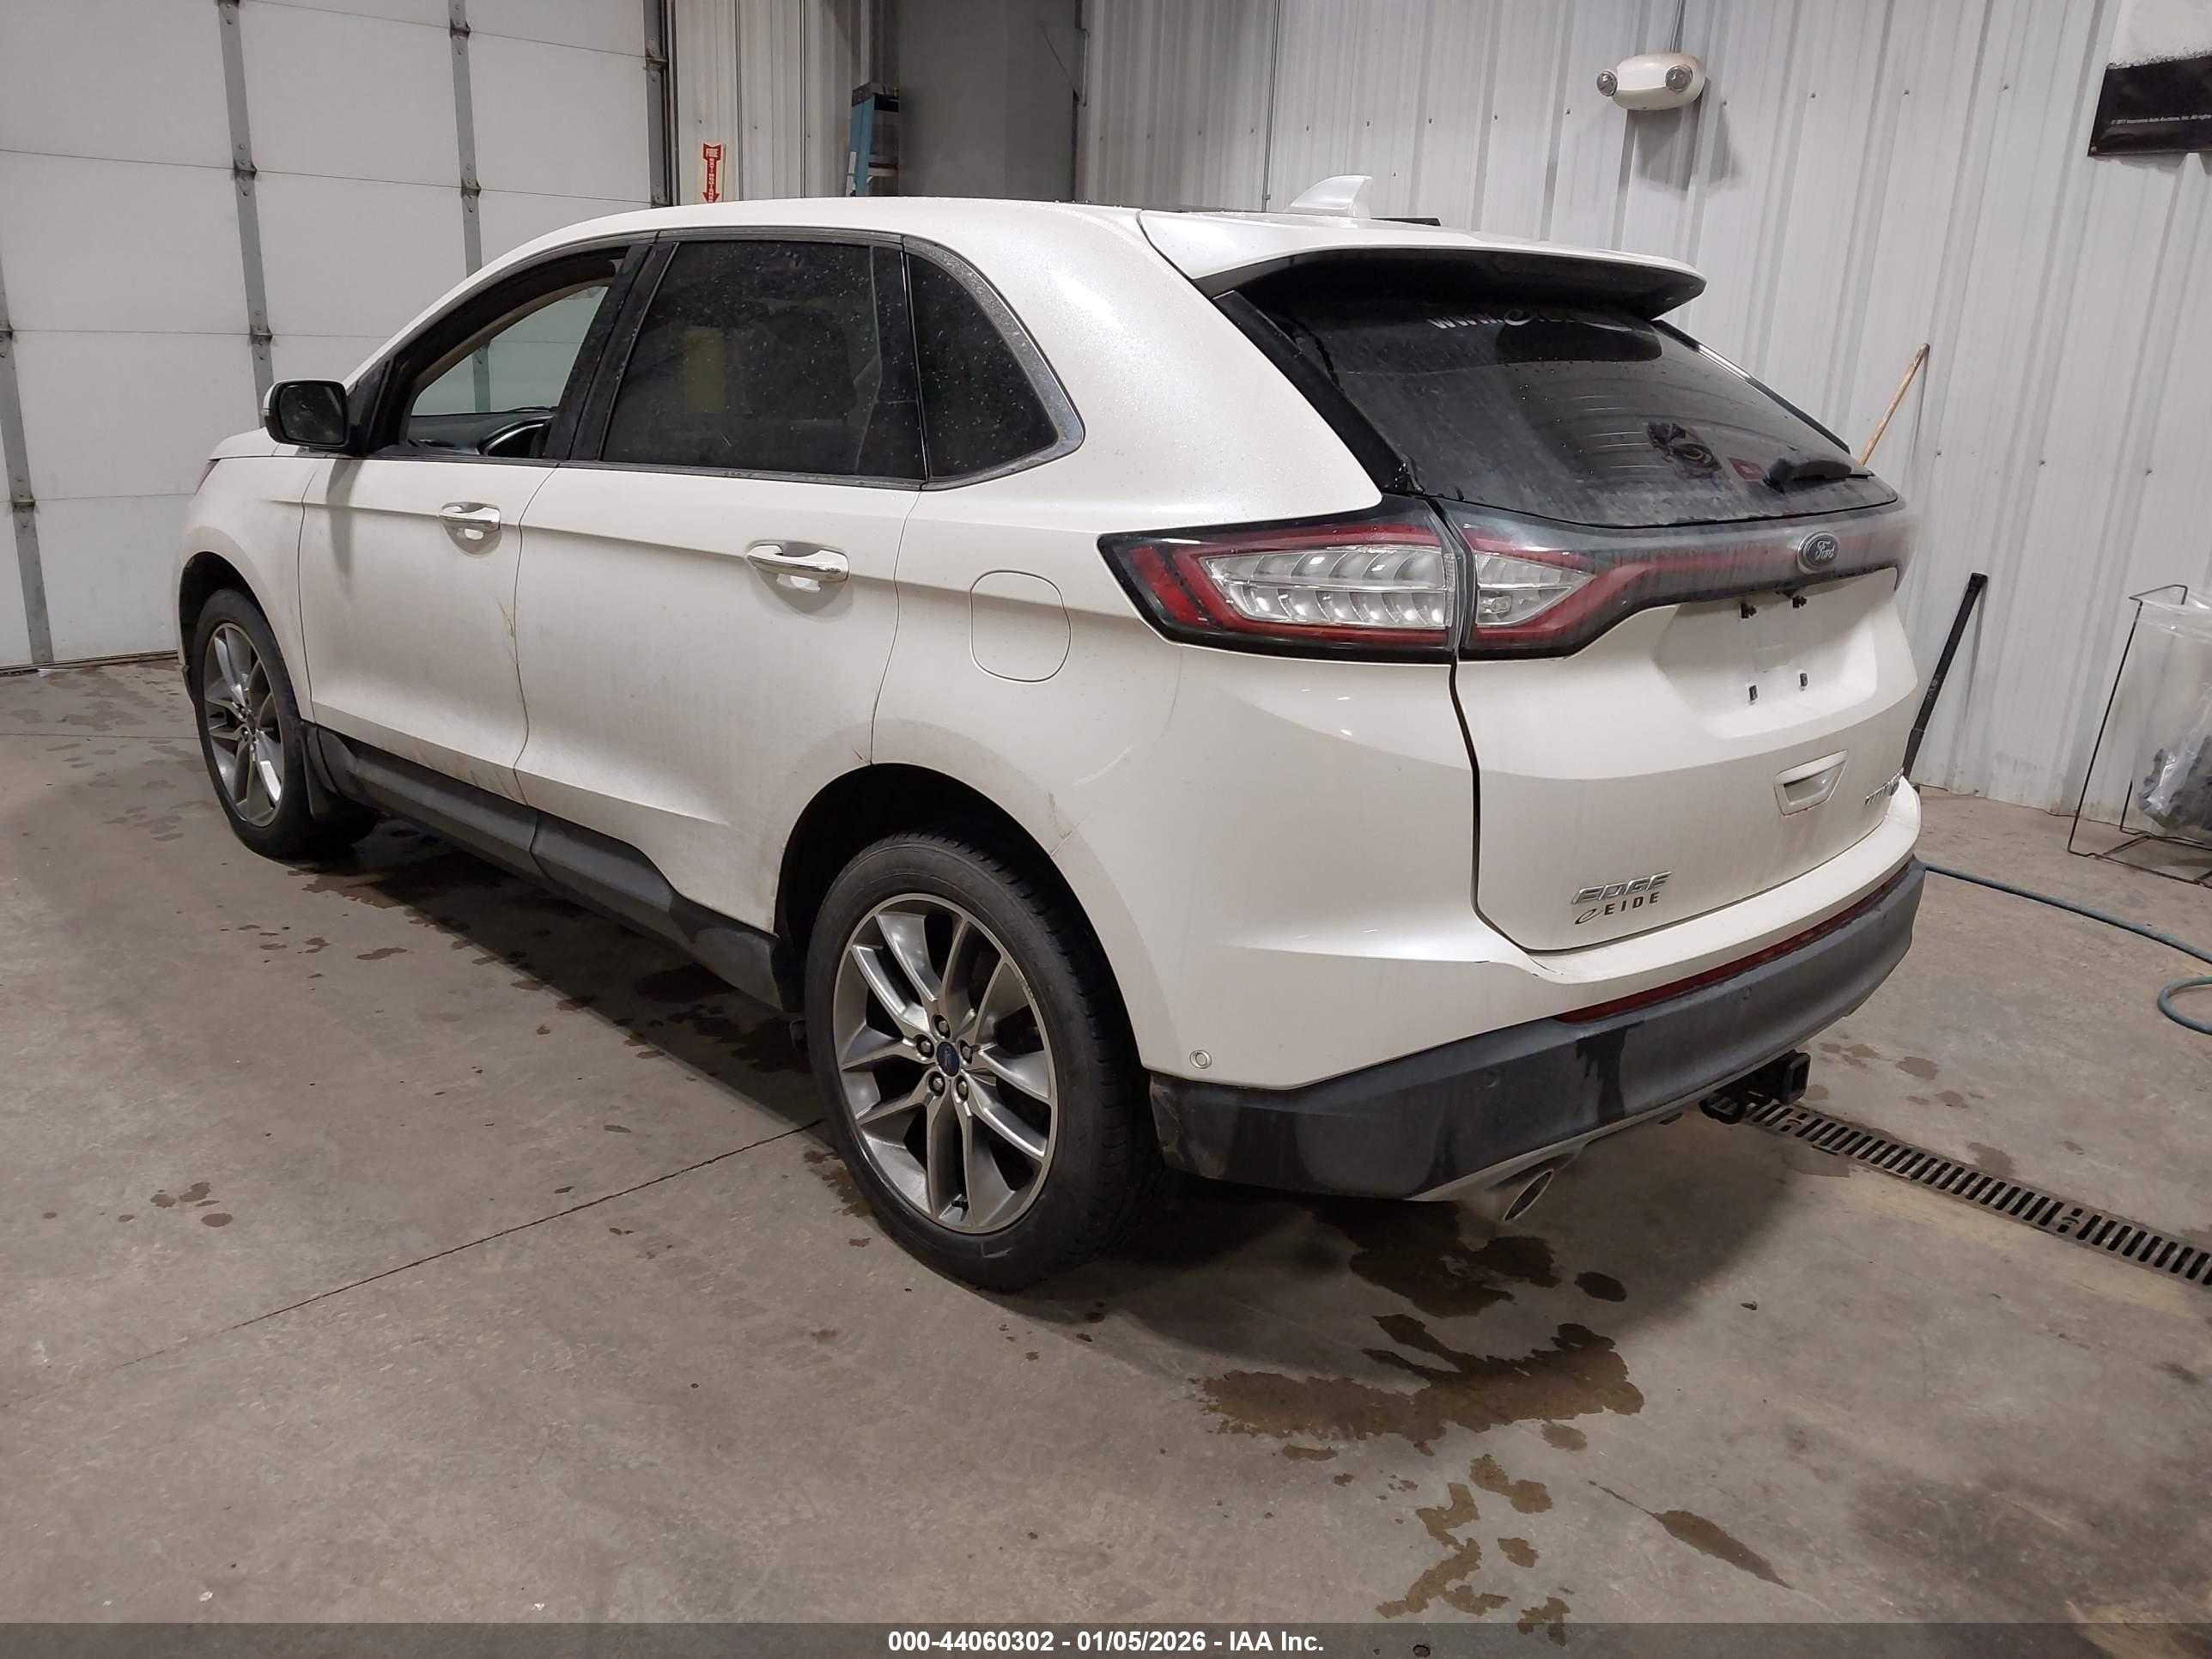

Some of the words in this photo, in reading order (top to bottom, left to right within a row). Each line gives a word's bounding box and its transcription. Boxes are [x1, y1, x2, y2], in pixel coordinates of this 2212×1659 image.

[1814, 540, 1836, 561] Ford
[1572, 871, 1672, 903] EDGE
[1603, 891, 1660, 916] EIDE
